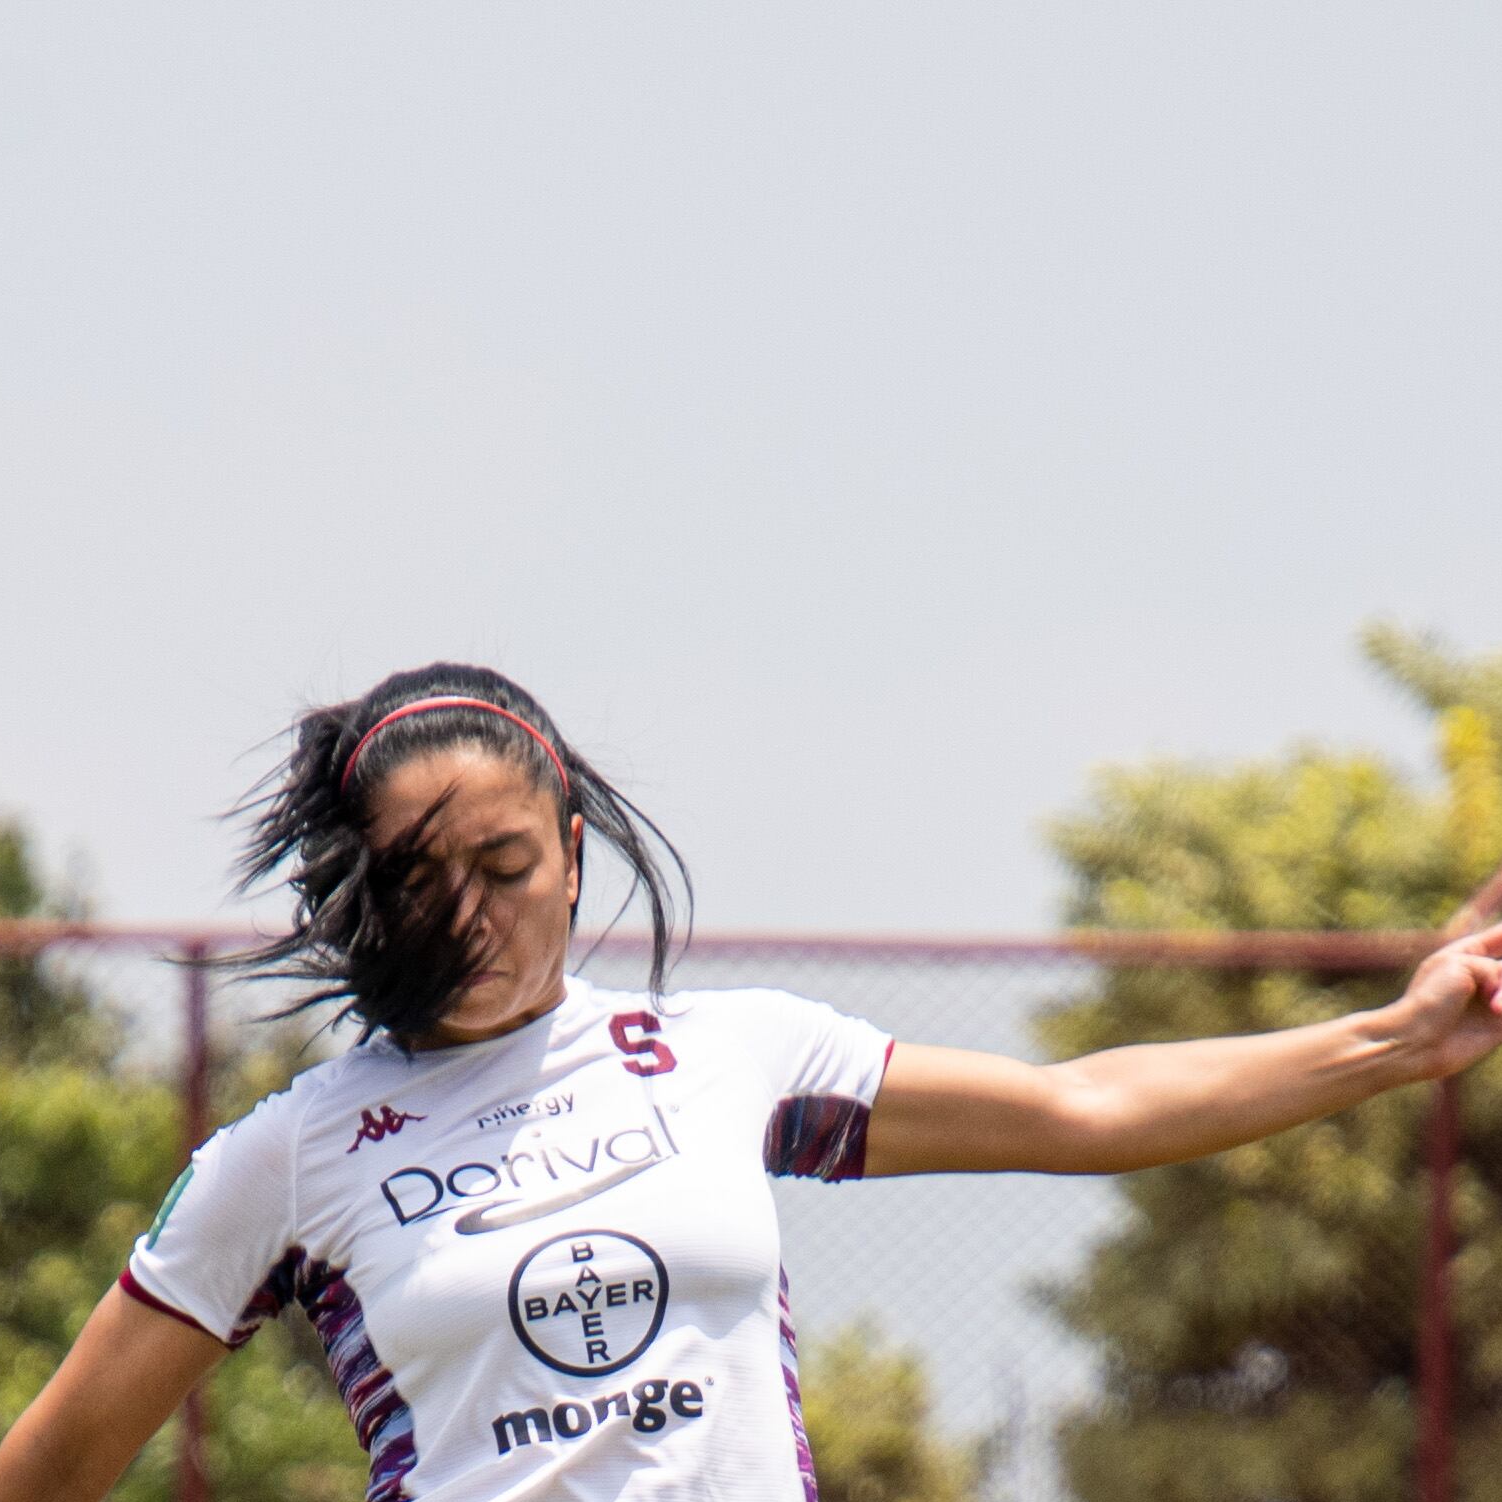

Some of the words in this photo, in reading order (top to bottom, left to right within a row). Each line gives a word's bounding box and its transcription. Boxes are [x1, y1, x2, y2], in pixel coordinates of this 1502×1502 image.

[609, 1011, 678, 1077] S
[380, 1104, 680, 1227] Dorival
[523, 1279, 655, 1322] BAYER
[570, 1240, 612, 1364] BAYER
[494, 1378, 704, 1456] monge
